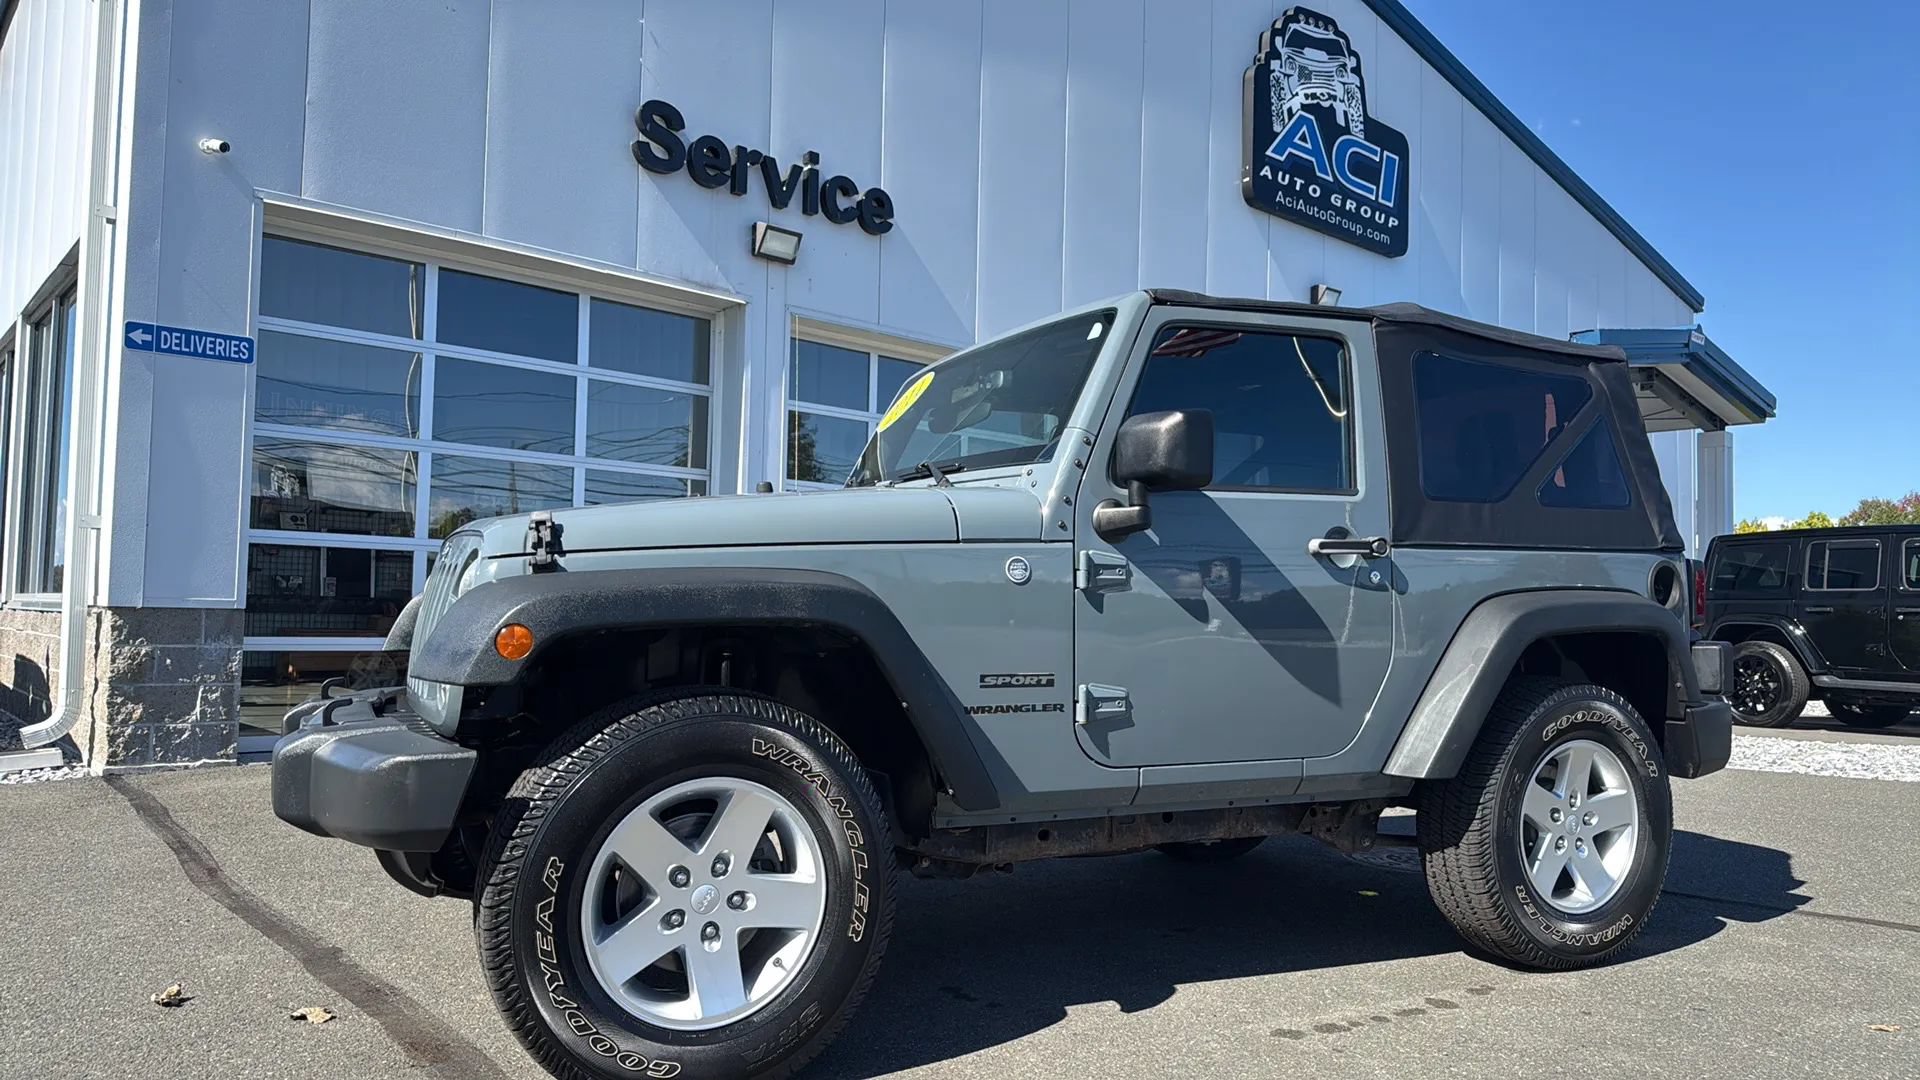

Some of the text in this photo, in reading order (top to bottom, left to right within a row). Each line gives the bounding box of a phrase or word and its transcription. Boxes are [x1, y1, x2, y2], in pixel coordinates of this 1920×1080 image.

[631, 99, 895, 235] Service
[1265, 110, 1399, 208] ACI
[1259, 165, 1399, 228] AUTO GROUP
[1275, 191, 1391, 245] AciAutoGroup.com
[160, 330, 249, 360] DELIVERIES
[963, 703, 1065, 715] WRANGLER
[980, 675, 1054, 686] SPORT
[1542, 710, 1658, 778] GOODYEAR
[752, 738, 870, 943] WRANGLER
[1515, 884, 1633, 946] WRANGLER
[536, 856, 682, 1079] GOODYEAR
